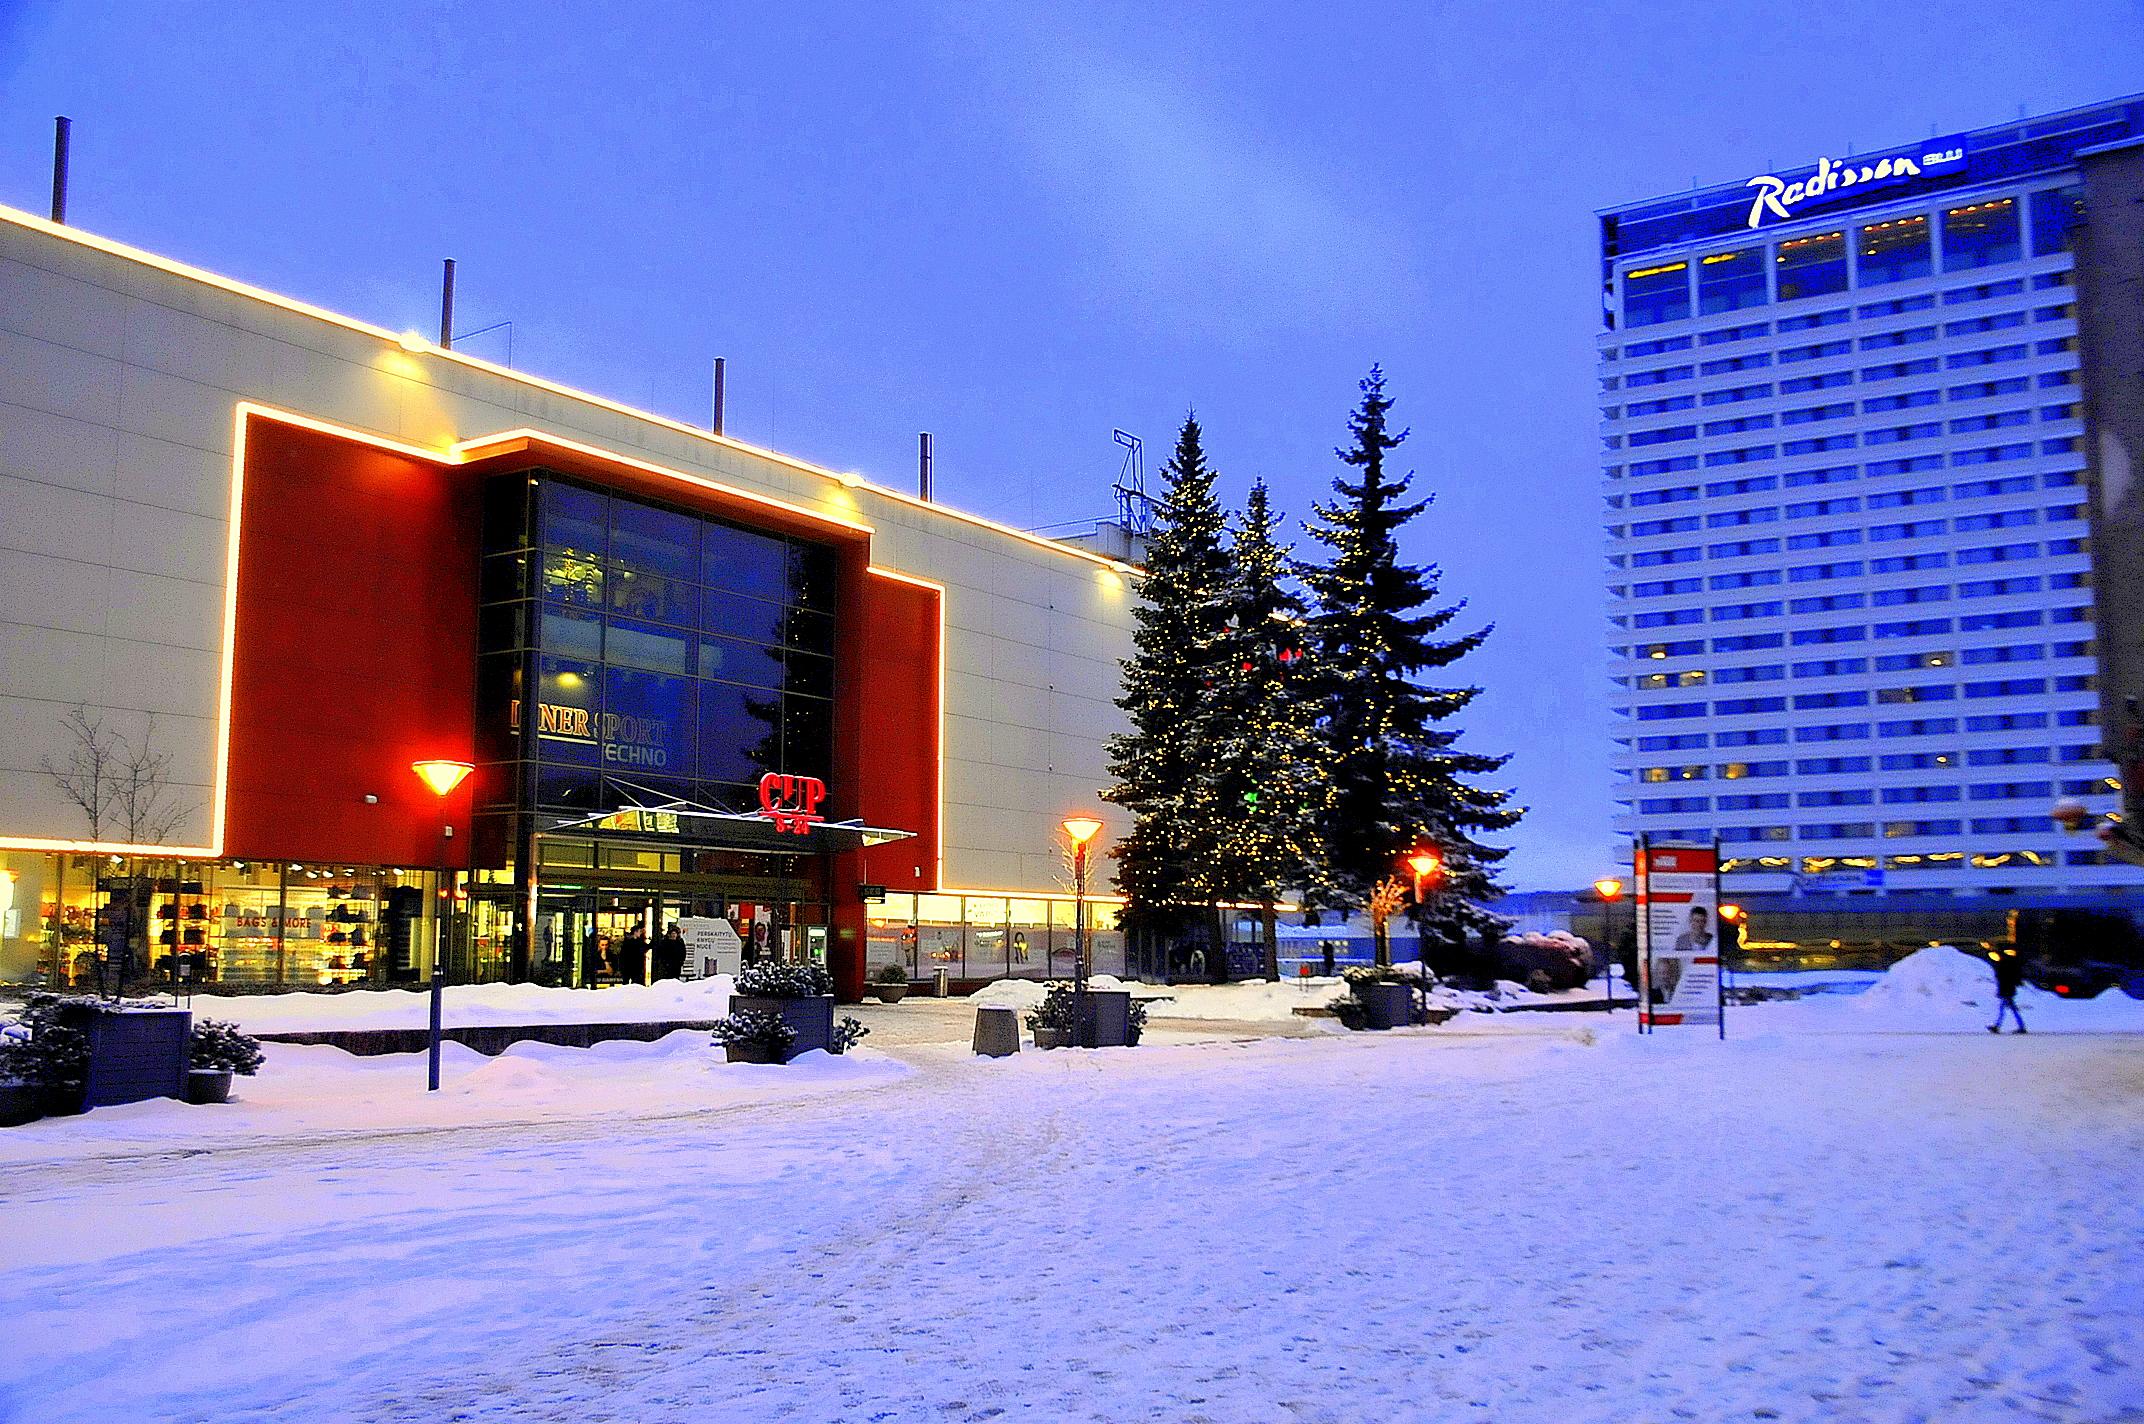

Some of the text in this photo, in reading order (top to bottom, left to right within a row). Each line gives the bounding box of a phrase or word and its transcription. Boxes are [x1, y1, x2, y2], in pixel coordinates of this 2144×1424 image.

[1746, 157, 1921, 228] Radisson
[759, 772, 827, 815] CUP
[237, 917, 312, 928] BAGS & MORE
